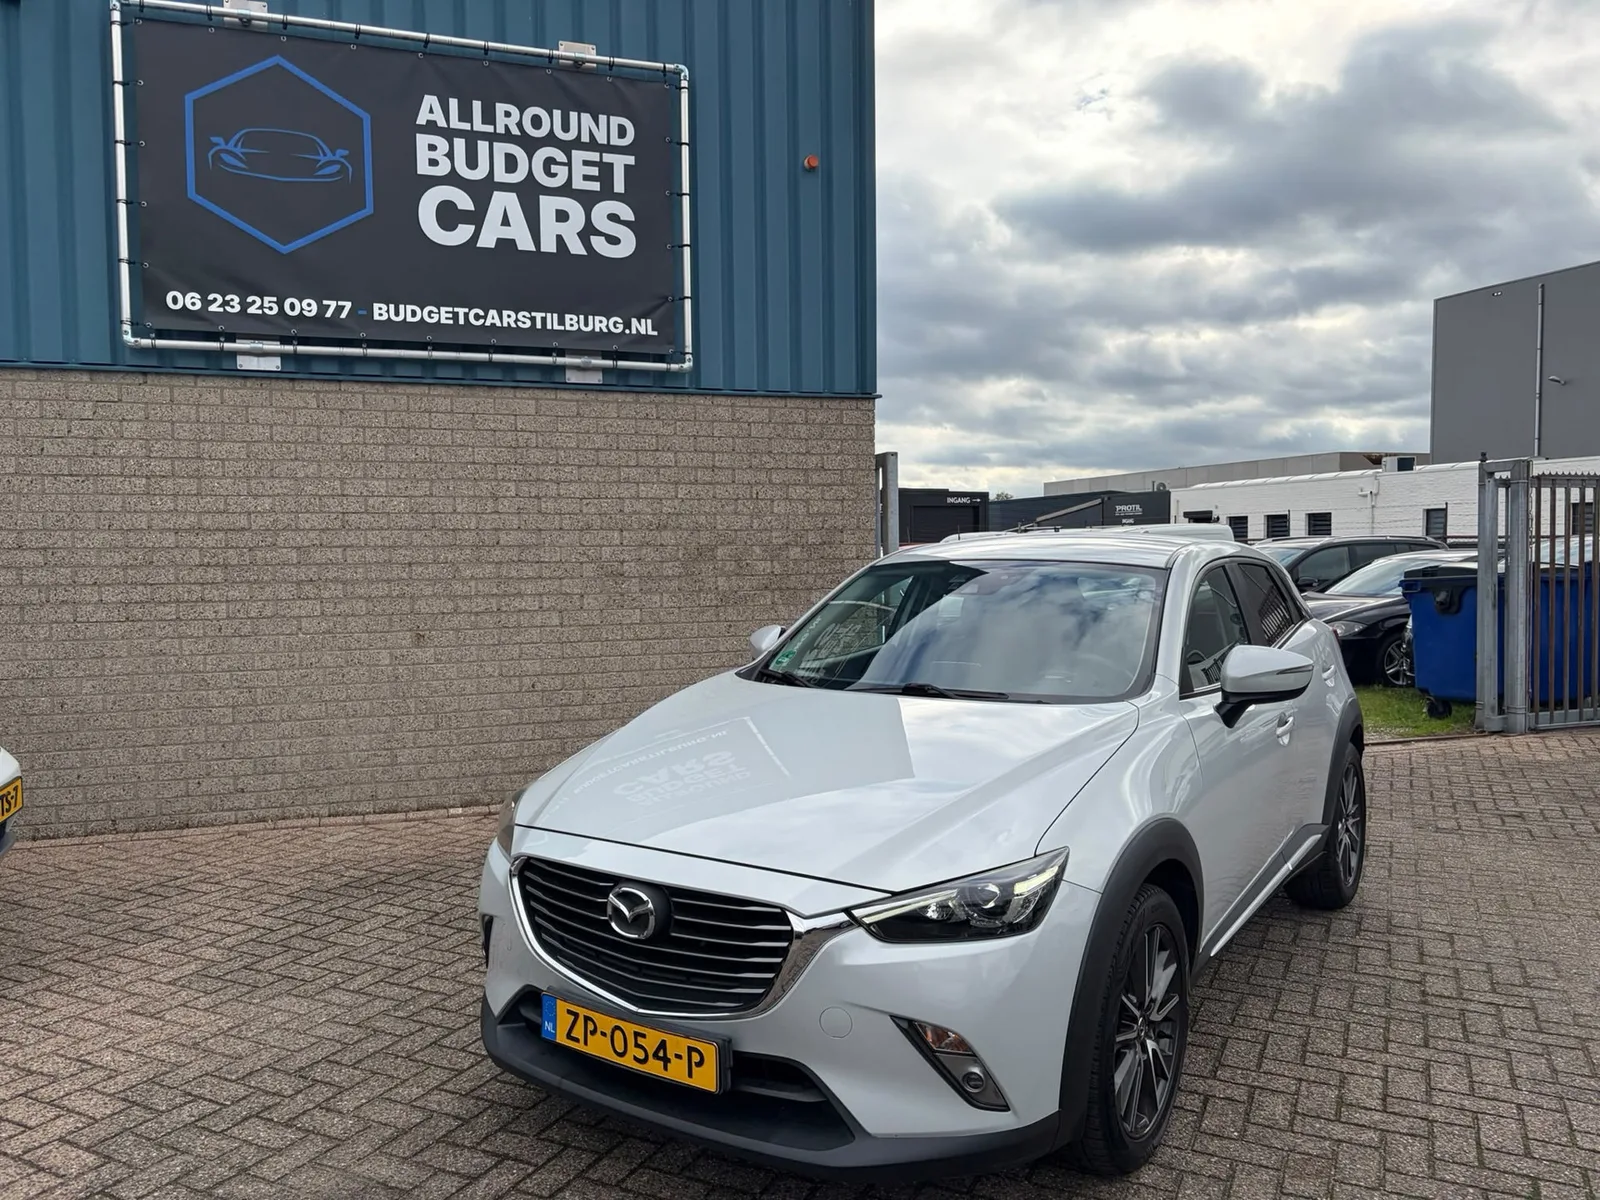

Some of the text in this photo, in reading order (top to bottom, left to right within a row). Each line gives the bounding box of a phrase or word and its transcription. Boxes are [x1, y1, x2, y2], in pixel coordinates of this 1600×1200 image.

[415, 94, 636, 147] ALLROUND
[415, 133, 636, 194] BUDGET
[418, 185, 637, 259] CARS
[165, 290, 202, 311] 06
[207, 293, 242, 314] 23
[246, 296, 279, 316] 25
[284, 298, 318, 318] 09
[322, 300, 352, 319] 77
[373, 303, 658, 336] BUDGETCARSTILBURG.NL
[946, 496, 971, 504] INGANG
[544, 1021, 556, 1033] NL
[566, 1008, 705, 1079] ZP-054-P
